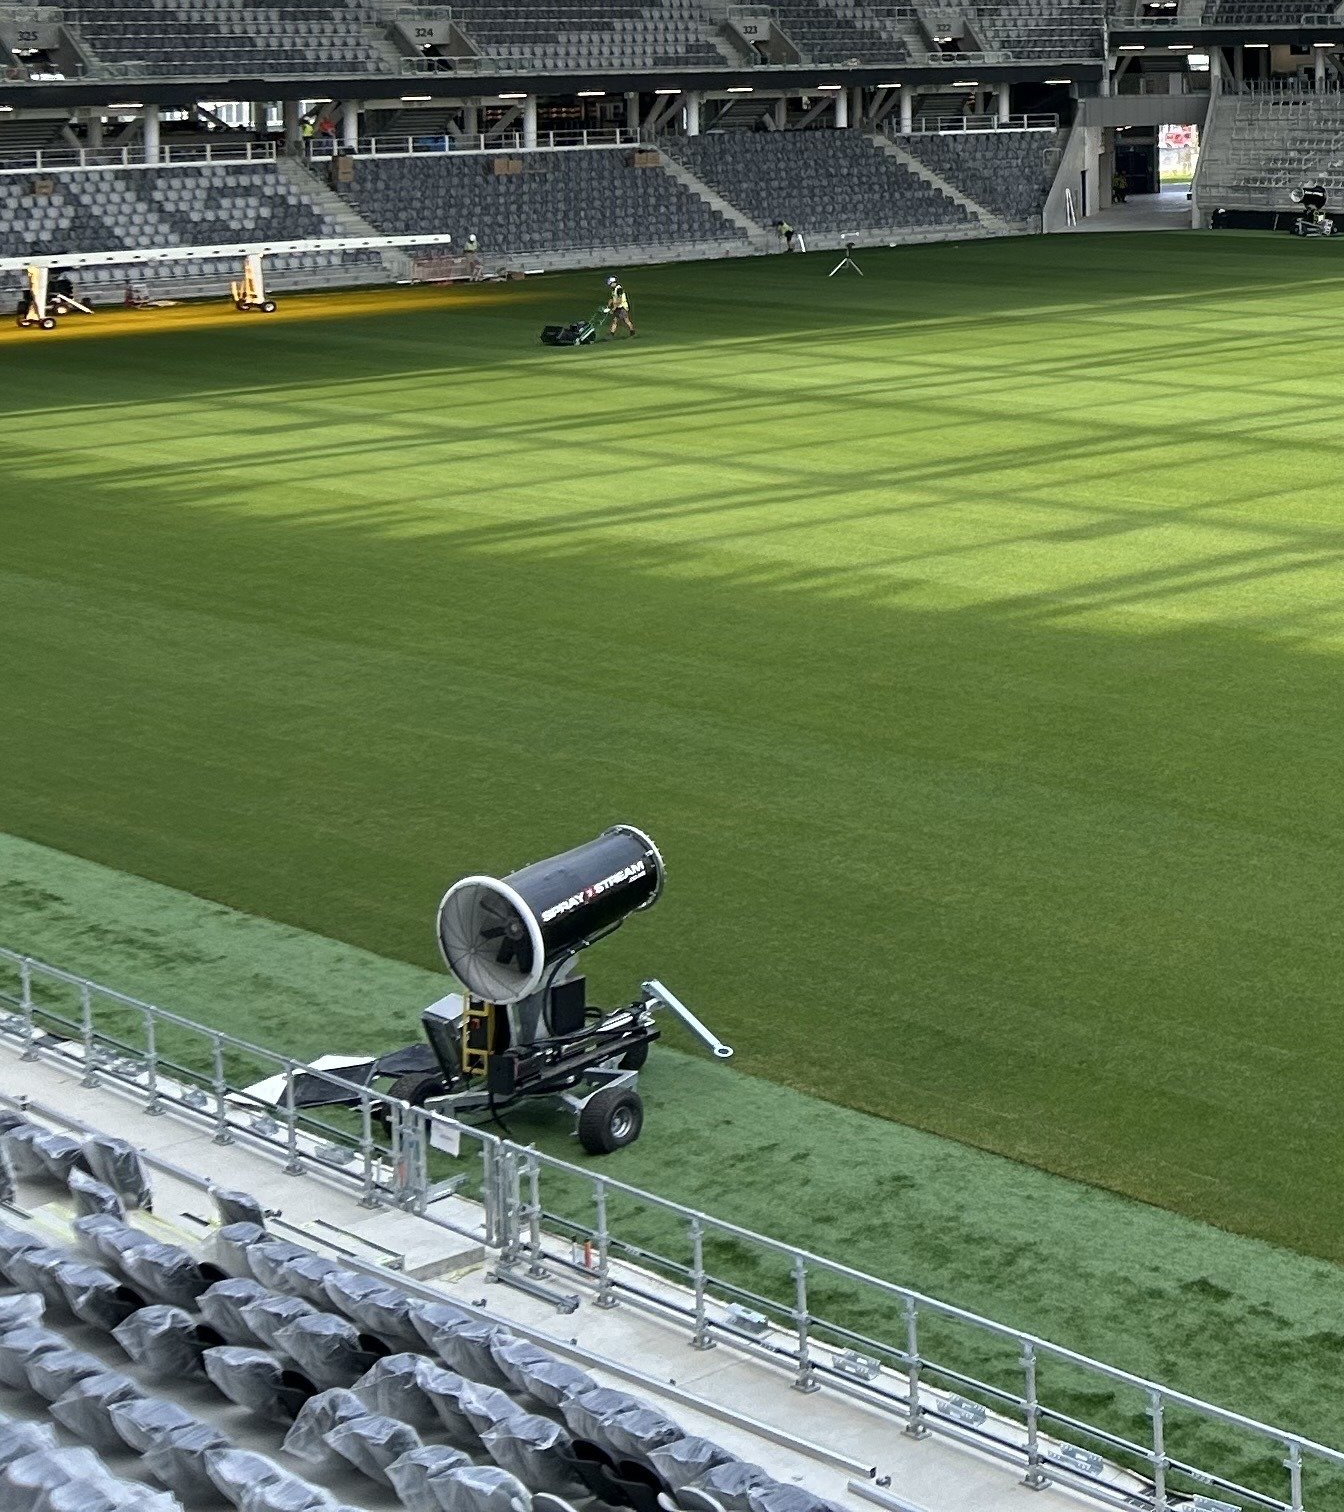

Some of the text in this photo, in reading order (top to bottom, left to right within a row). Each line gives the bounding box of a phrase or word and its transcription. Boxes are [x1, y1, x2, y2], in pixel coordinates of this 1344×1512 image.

[414, 27, 434, 38] 324
[742, 25, 758, 35] 323
[18, 30, 39, 42] 325
[541, 891, 585, 922] SPRAY
[593, 860, 645, 894] STREAM
